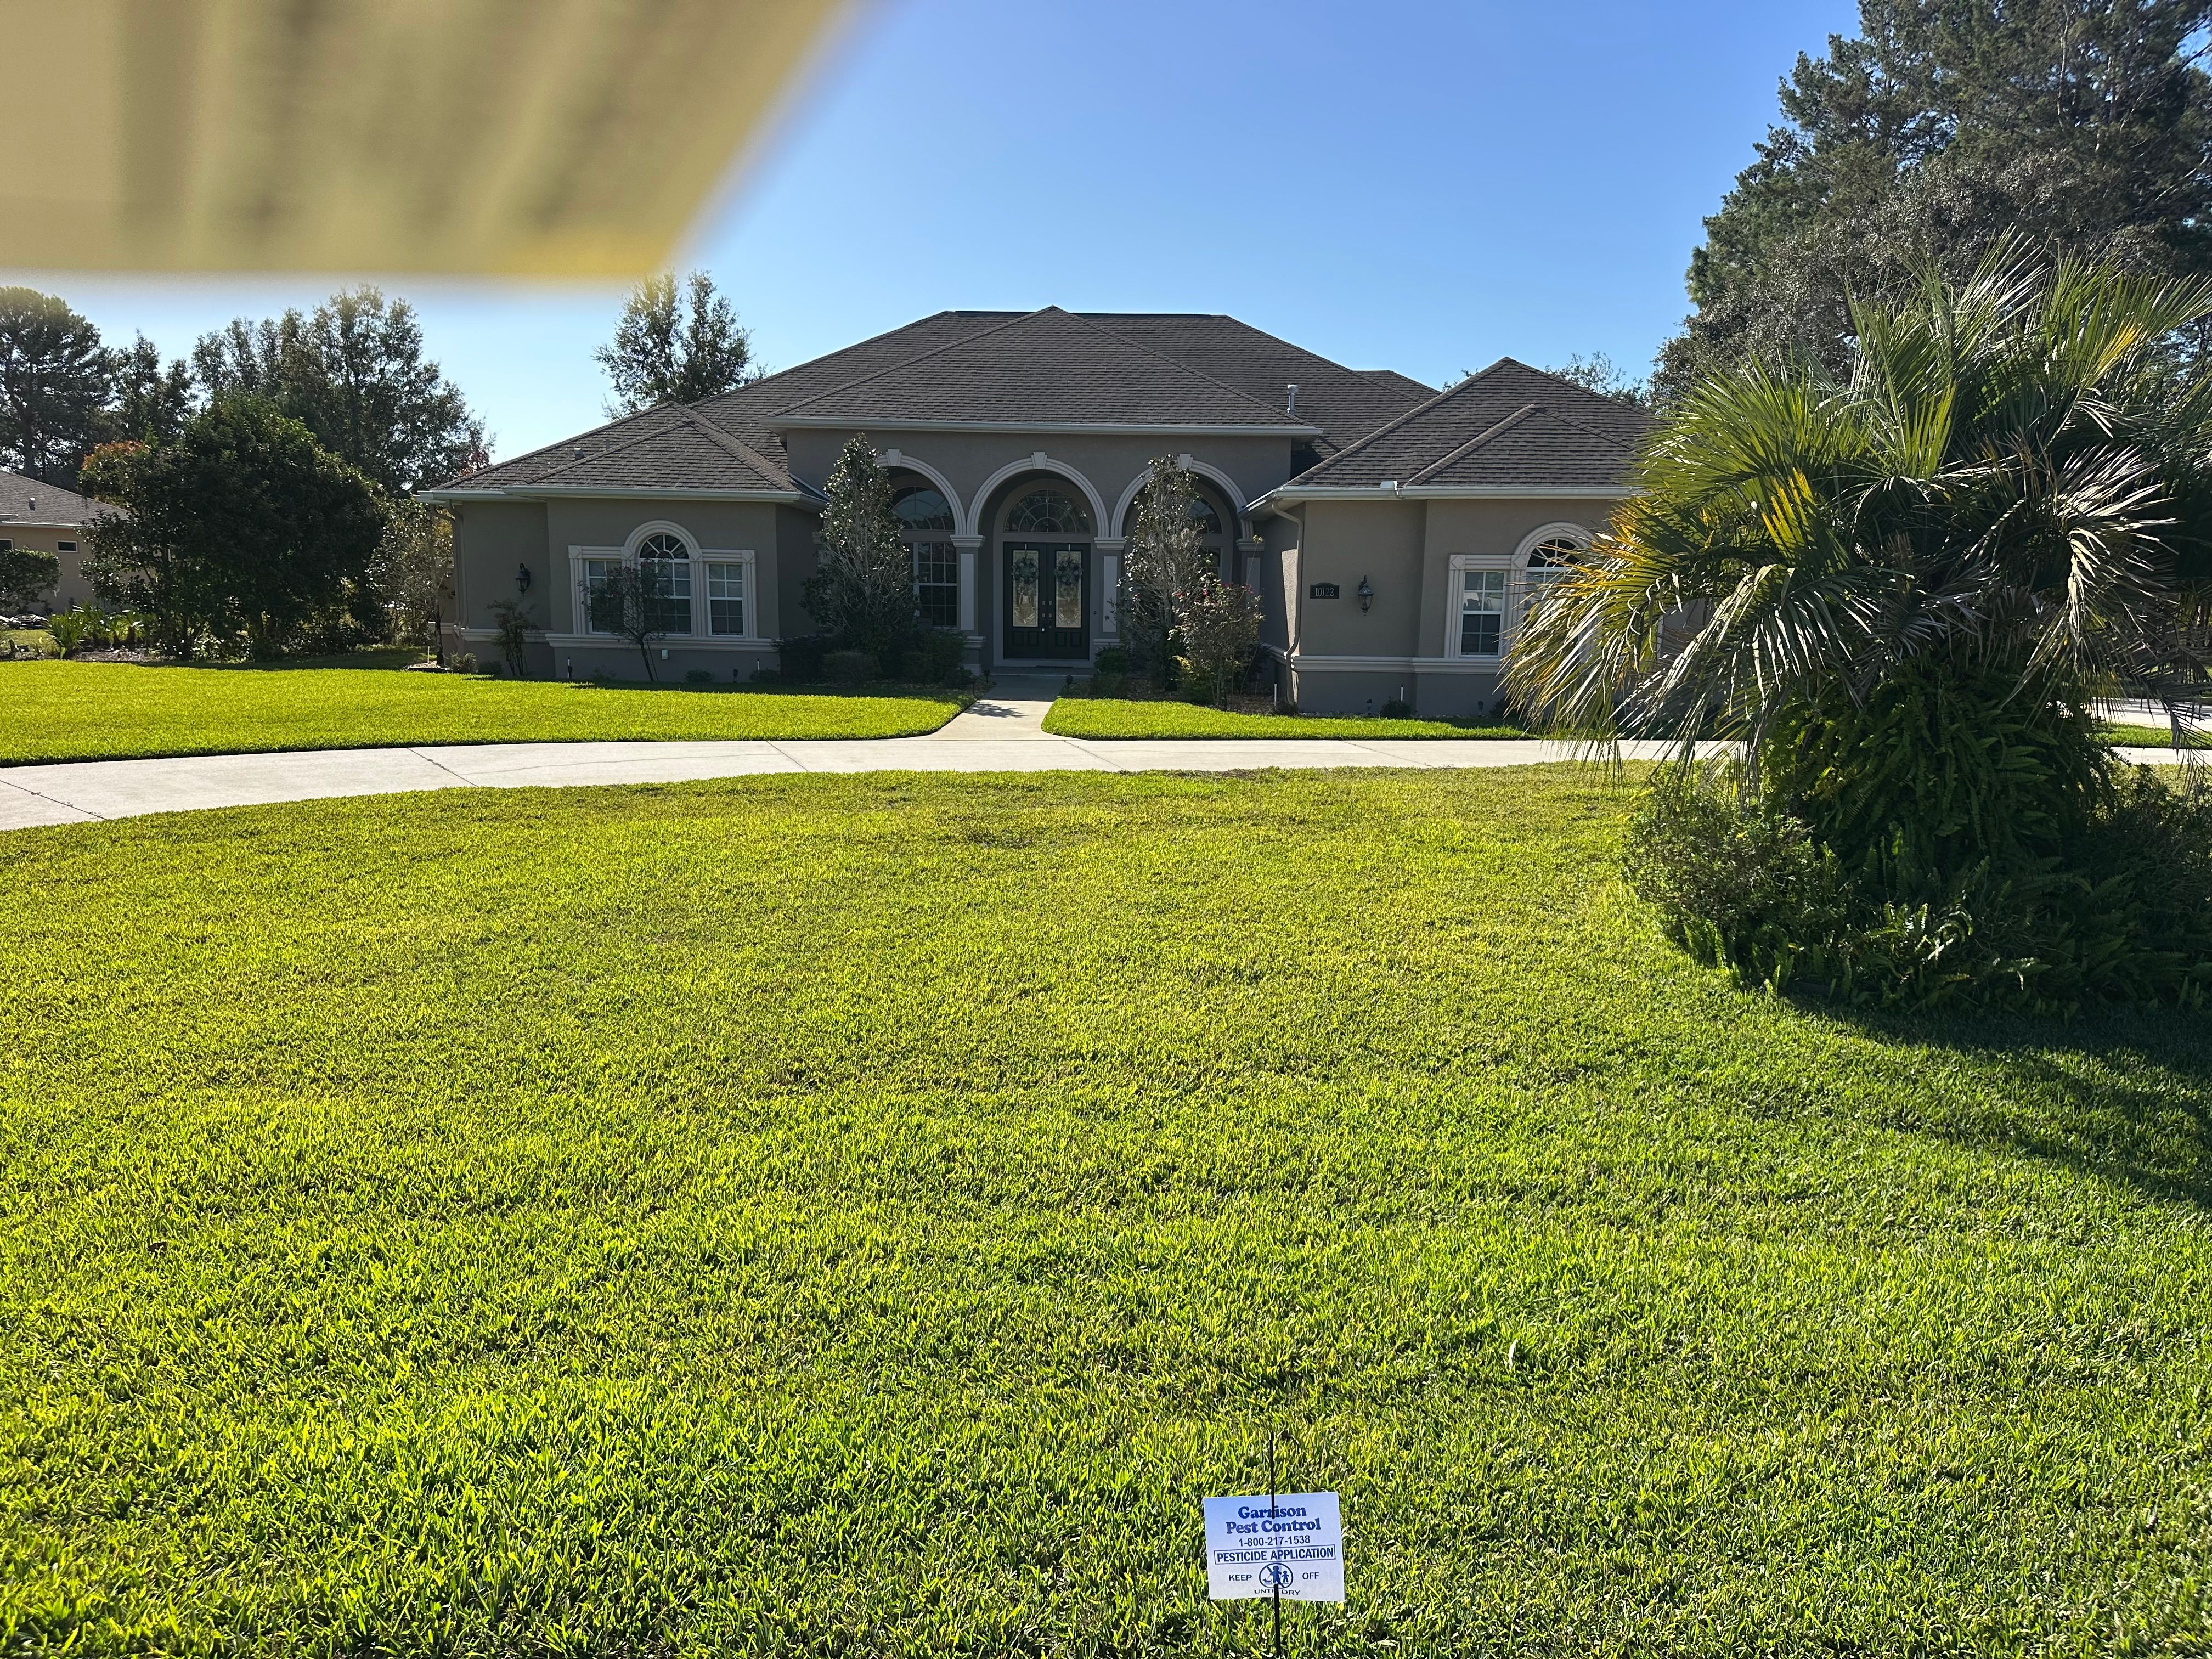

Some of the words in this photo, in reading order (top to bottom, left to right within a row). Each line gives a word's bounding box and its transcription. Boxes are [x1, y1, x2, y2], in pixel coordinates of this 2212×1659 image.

[1316, 588, 1334, 596] 10122
[1226, 1521, 1258, 1533] Pest
[1261, 1518, 1321, 1533] Control
[1238, 1535, 1310, 1547] 1-800-217-1538
[1217, 1551, 1267, 1562] PESTICIDE
[1271, 1548, 1333, 1560] APPLICATION
